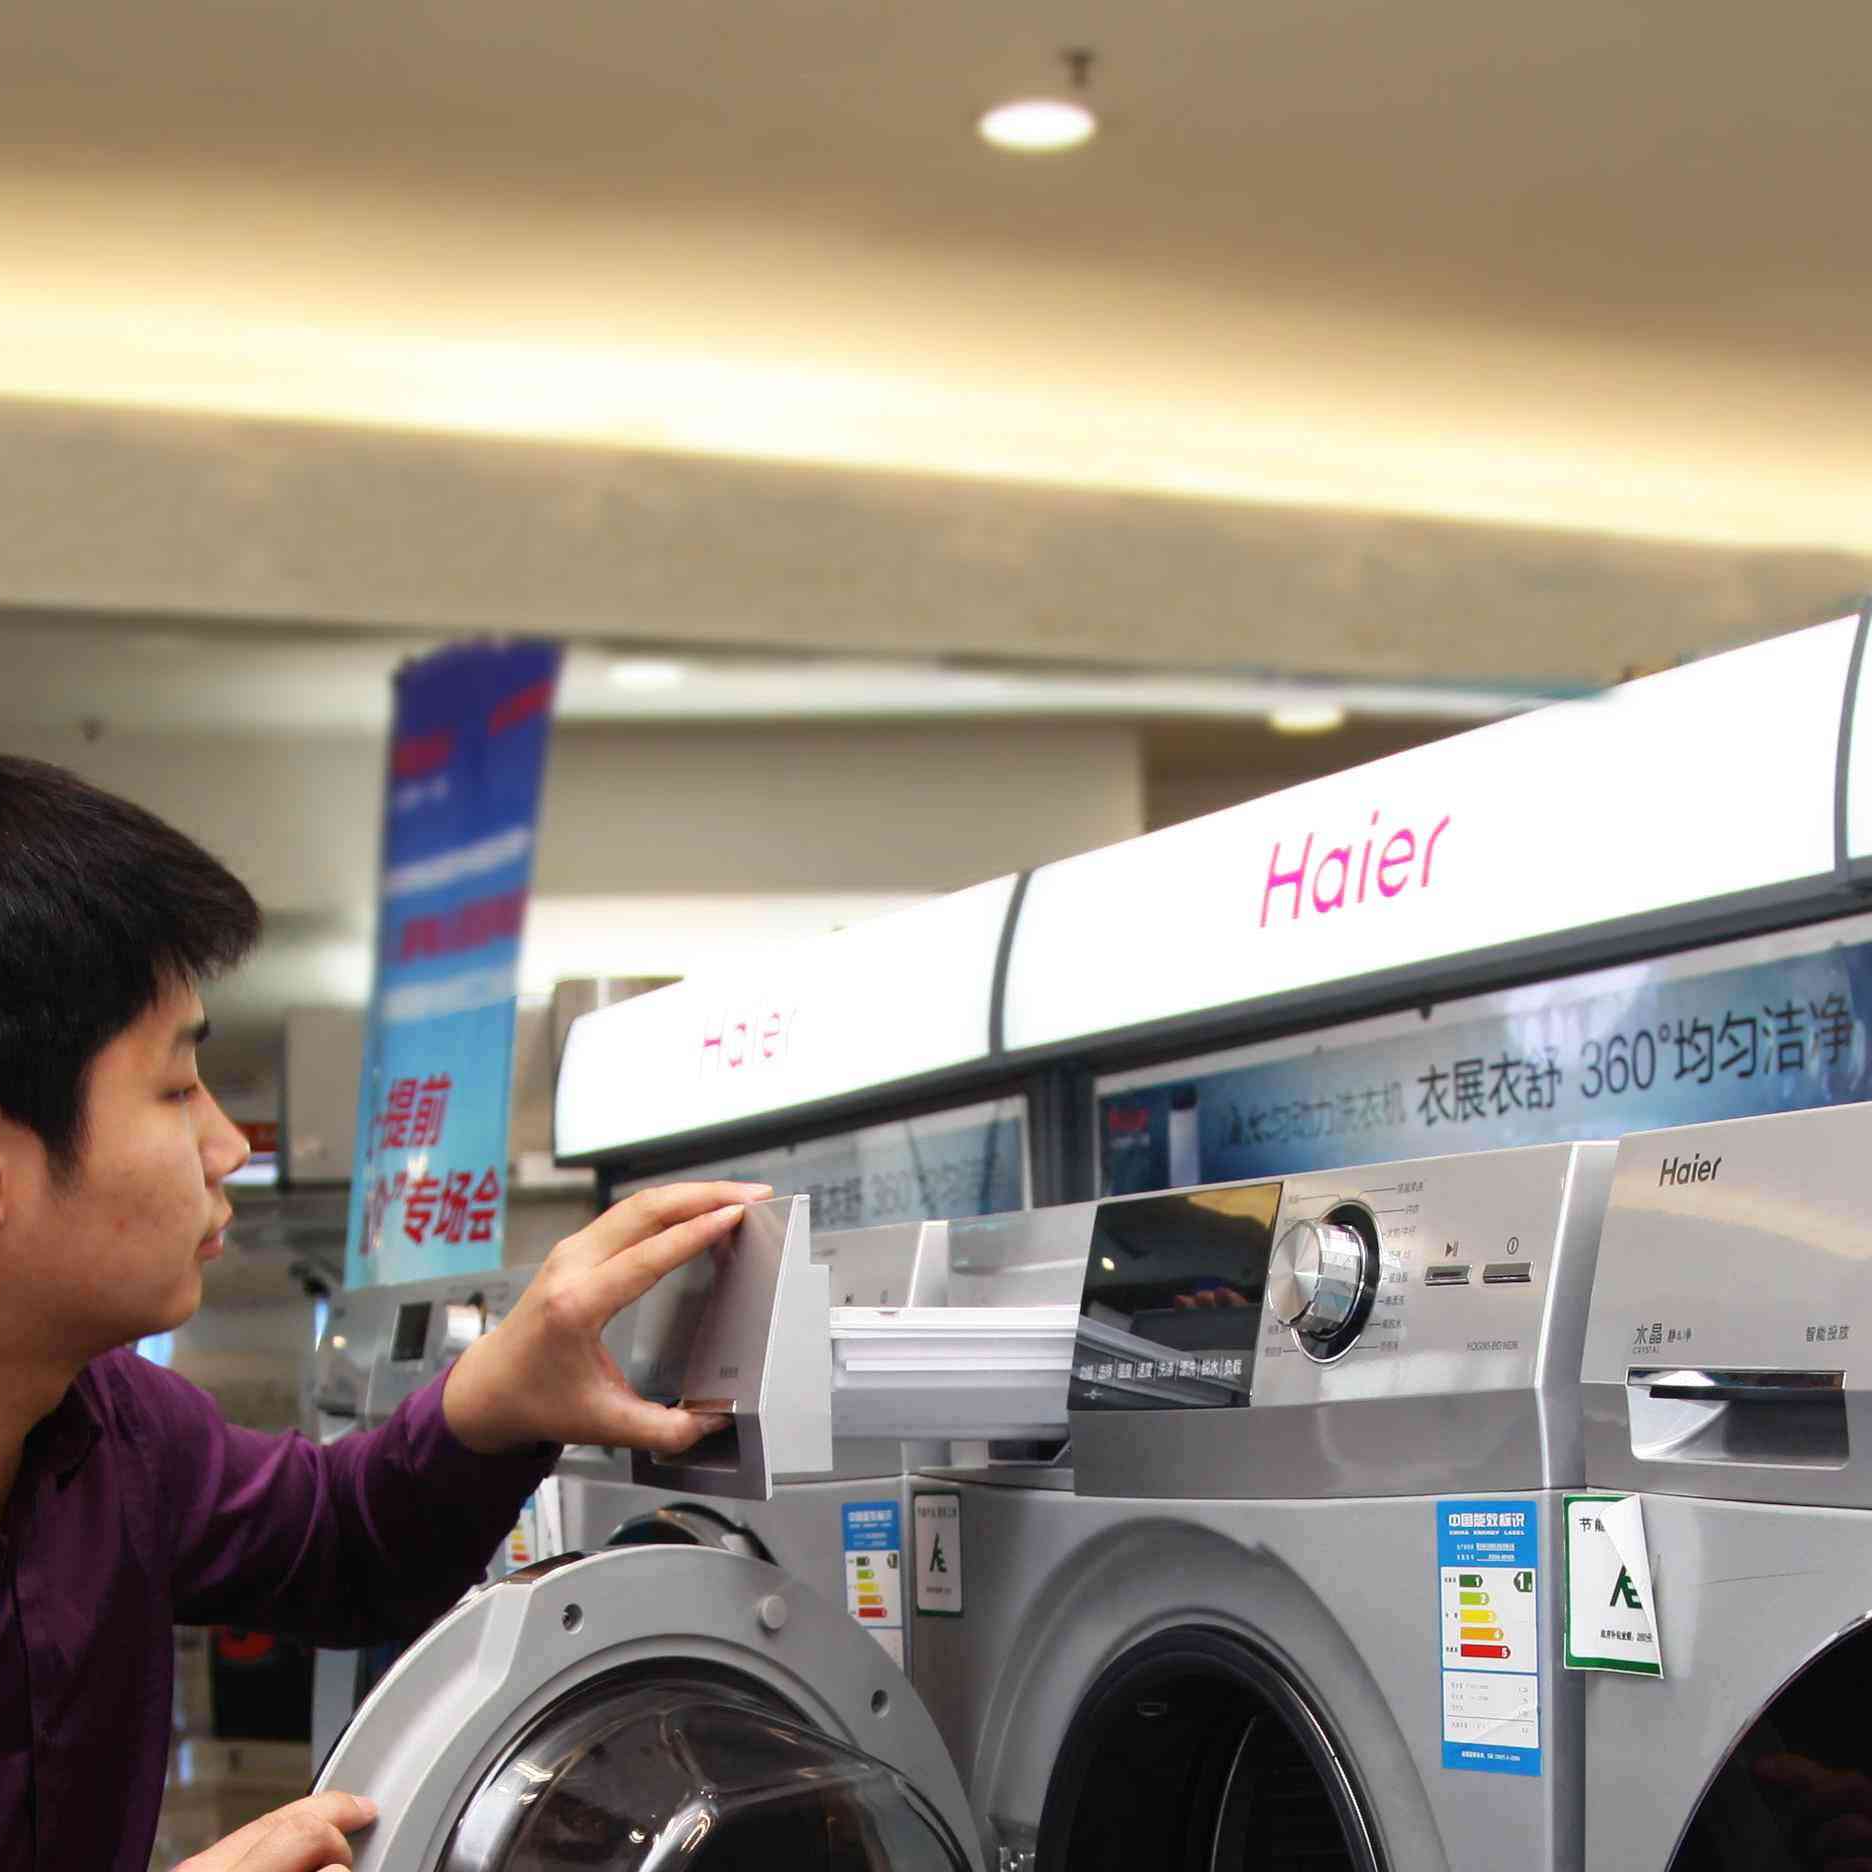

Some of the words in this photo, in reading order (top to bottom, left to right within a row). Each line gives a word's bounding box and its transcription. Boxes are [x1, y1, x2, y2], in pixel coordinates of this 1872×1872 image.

[1260, 810, 1451, 927] Haier
[1417, 1044, 1563, 1126] 衣展衣舒
[1579, 993, 1853, 1099] 360°均匀洁净
[1658, 1154, 1722, 1187] Haier
[1634, 1323, 1662, 1344] 水晶
